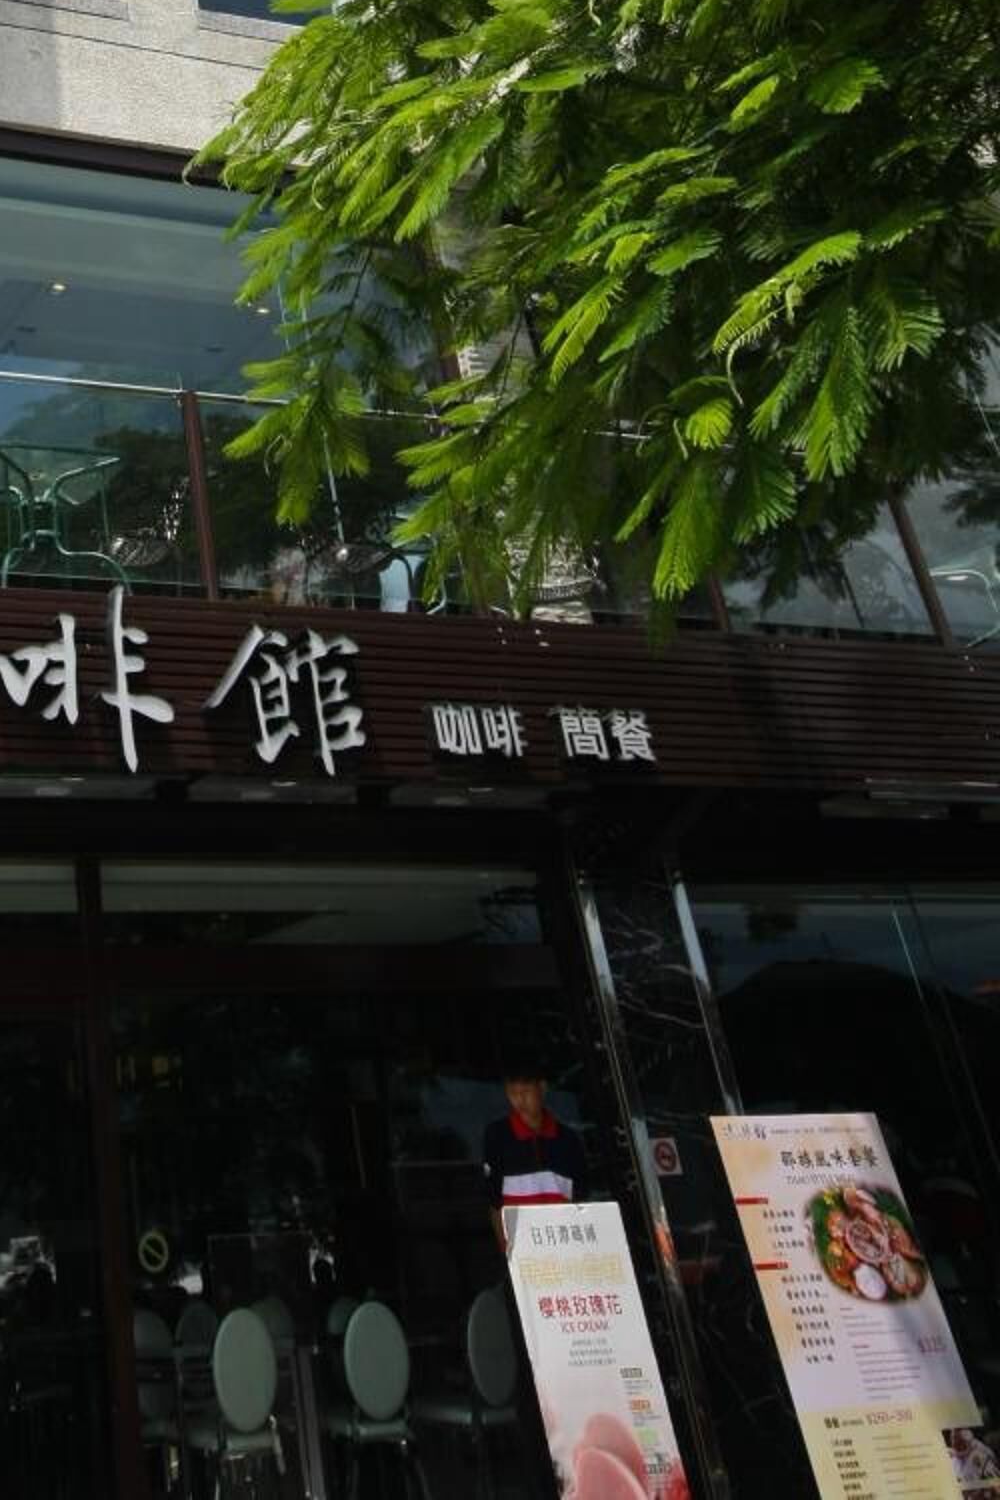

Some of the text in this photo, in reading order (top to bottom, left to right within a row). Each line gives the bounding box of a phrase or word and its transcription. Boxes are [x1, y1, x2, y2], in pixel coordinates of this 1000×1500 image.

[433, 703, 657, 763] 咖啡 簡餐
[538, 1293, 623, 1319] 櫻桃玫瑰花
